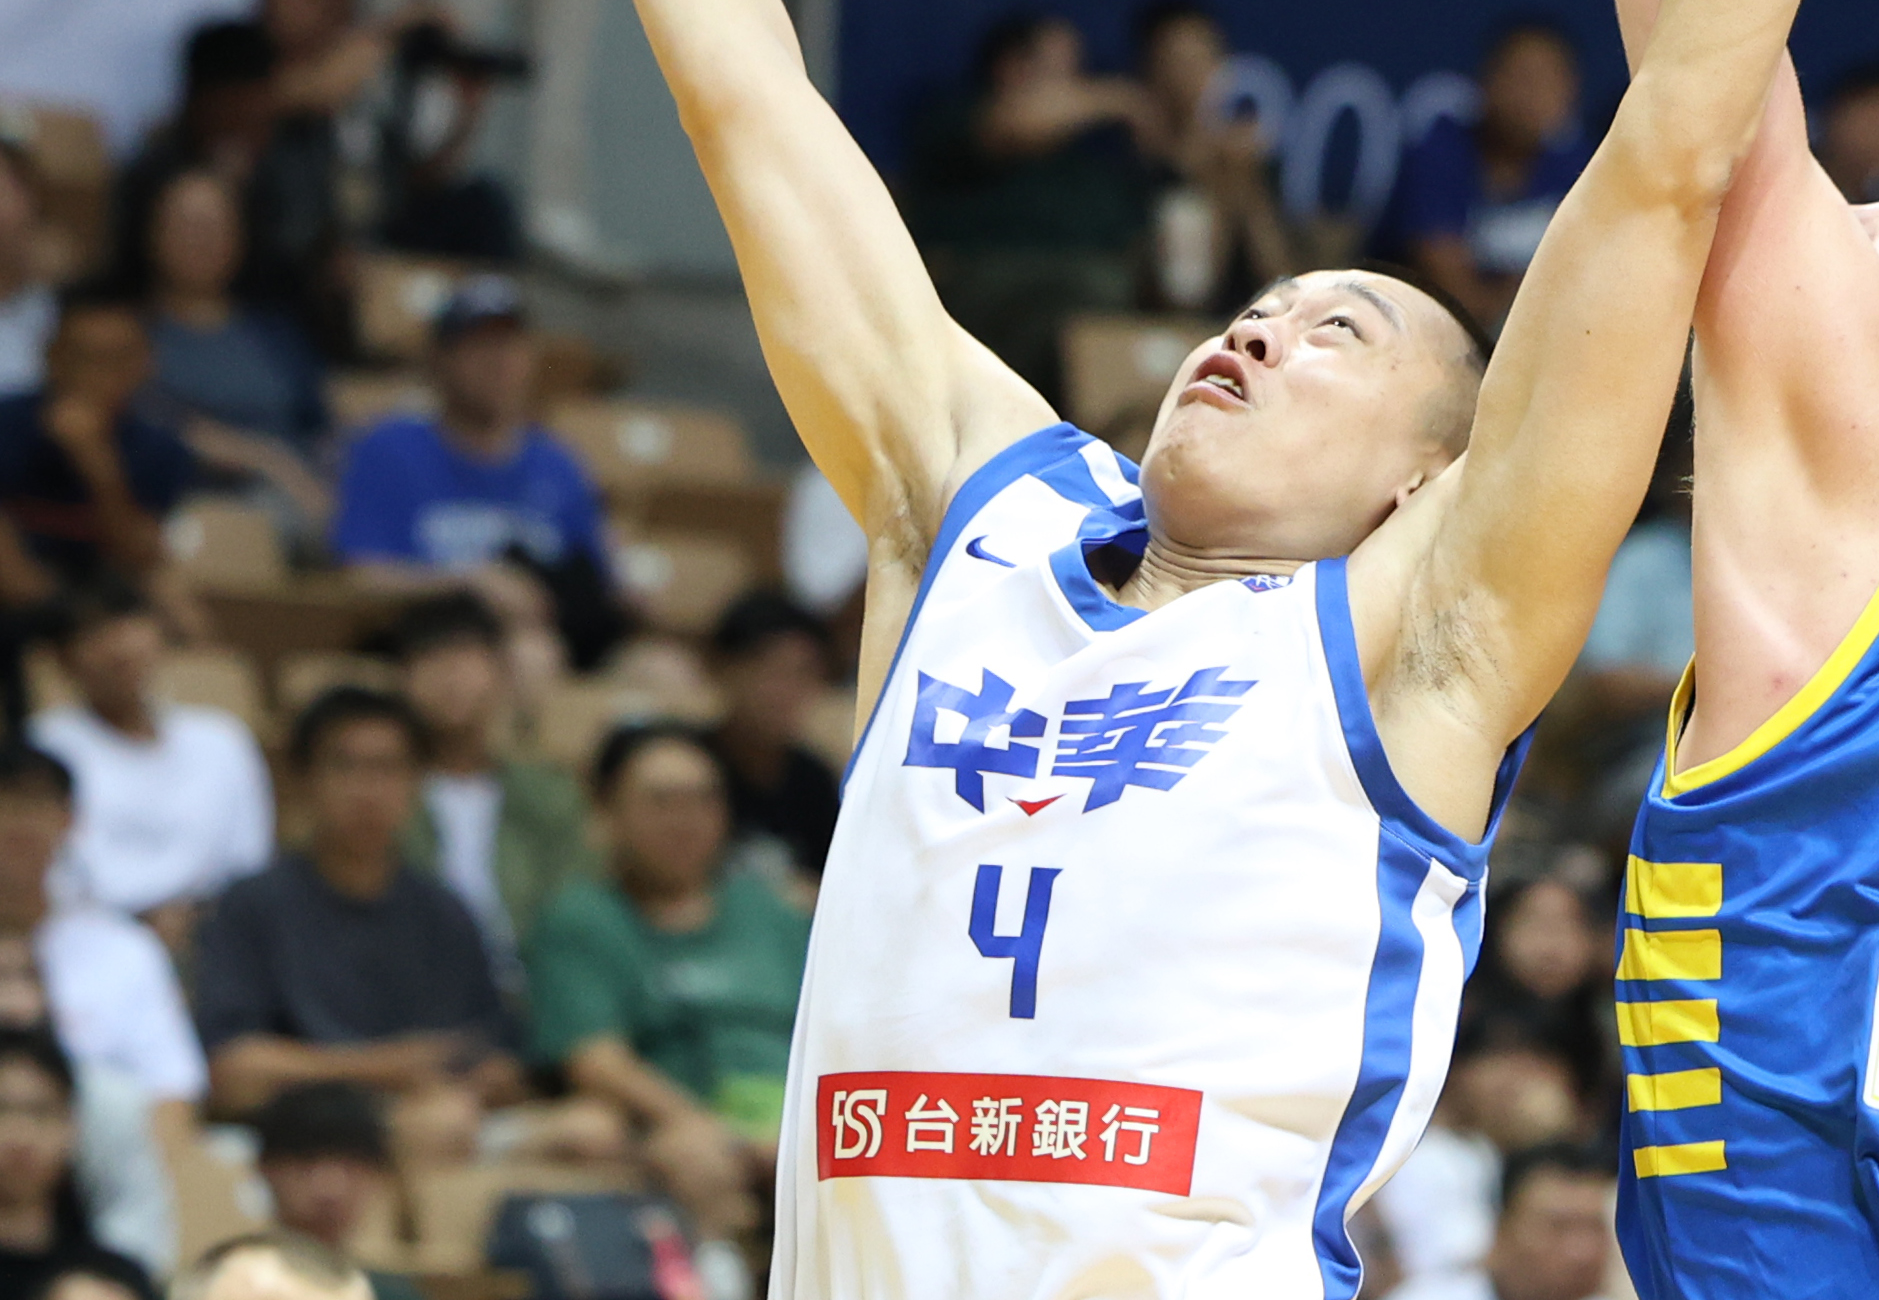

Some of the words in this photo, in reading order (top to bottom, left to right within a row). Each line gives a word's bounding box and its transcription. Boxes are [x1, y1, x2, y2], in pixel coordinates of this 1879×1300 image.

[901, 665, 1260, 815] 中華
[968, 864, 1064, 1021] 4
[904, 1093, 1160, 1165] 台新銀行
